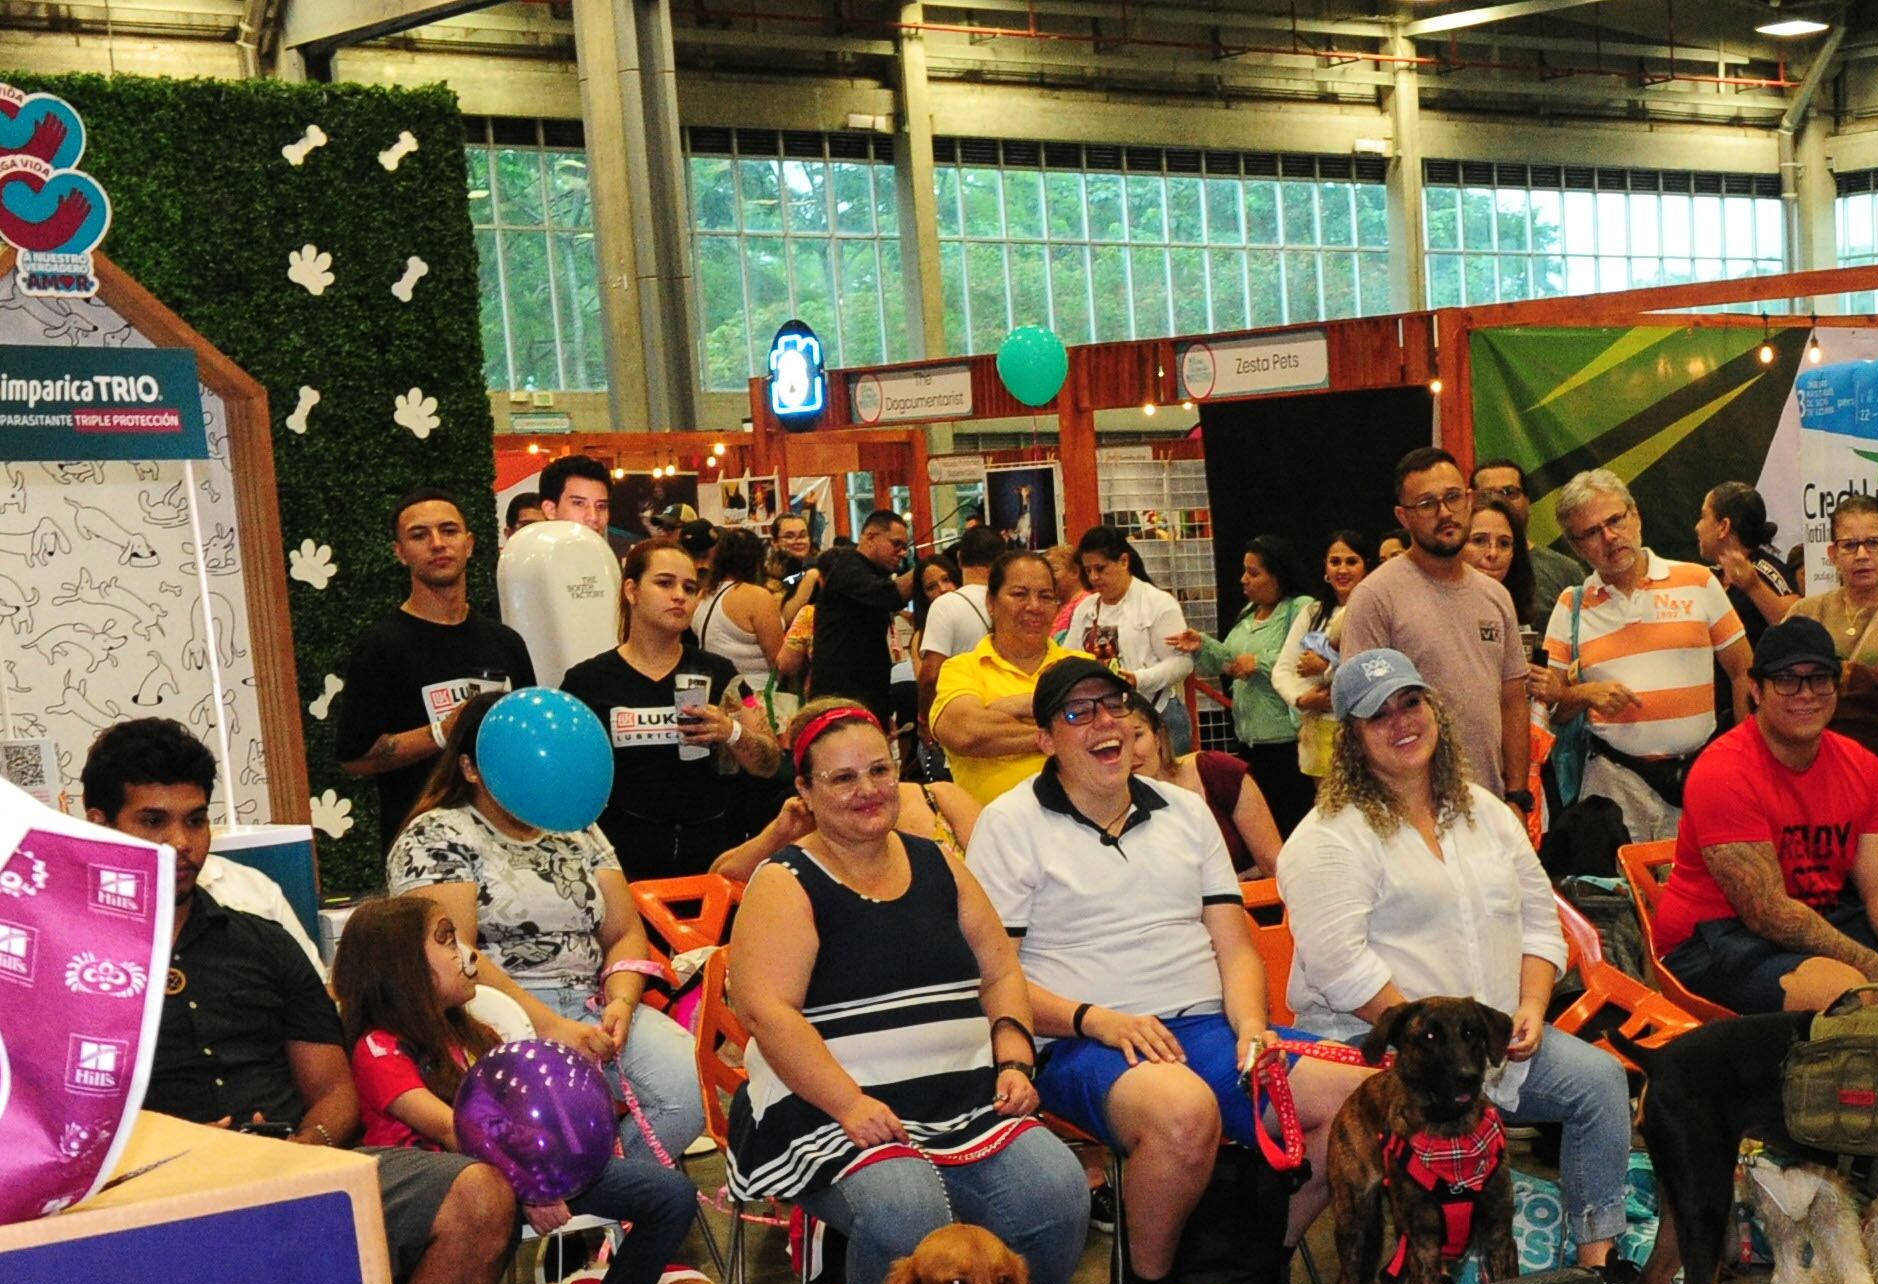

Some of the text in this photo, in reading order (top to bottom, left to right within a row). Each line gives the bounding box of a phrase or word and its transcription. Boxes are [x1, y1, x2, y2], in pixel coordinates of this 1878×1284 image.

[20, 159, 51, 178] VIDA
[1236, 353, 1300, 375] Zesta Pets
[913, 371, 932, 385] The
[0, 412, 179, 428] PARASITANTE TRIPLE PROTECCIÓN
[0, 954, 29, 976] ill's
